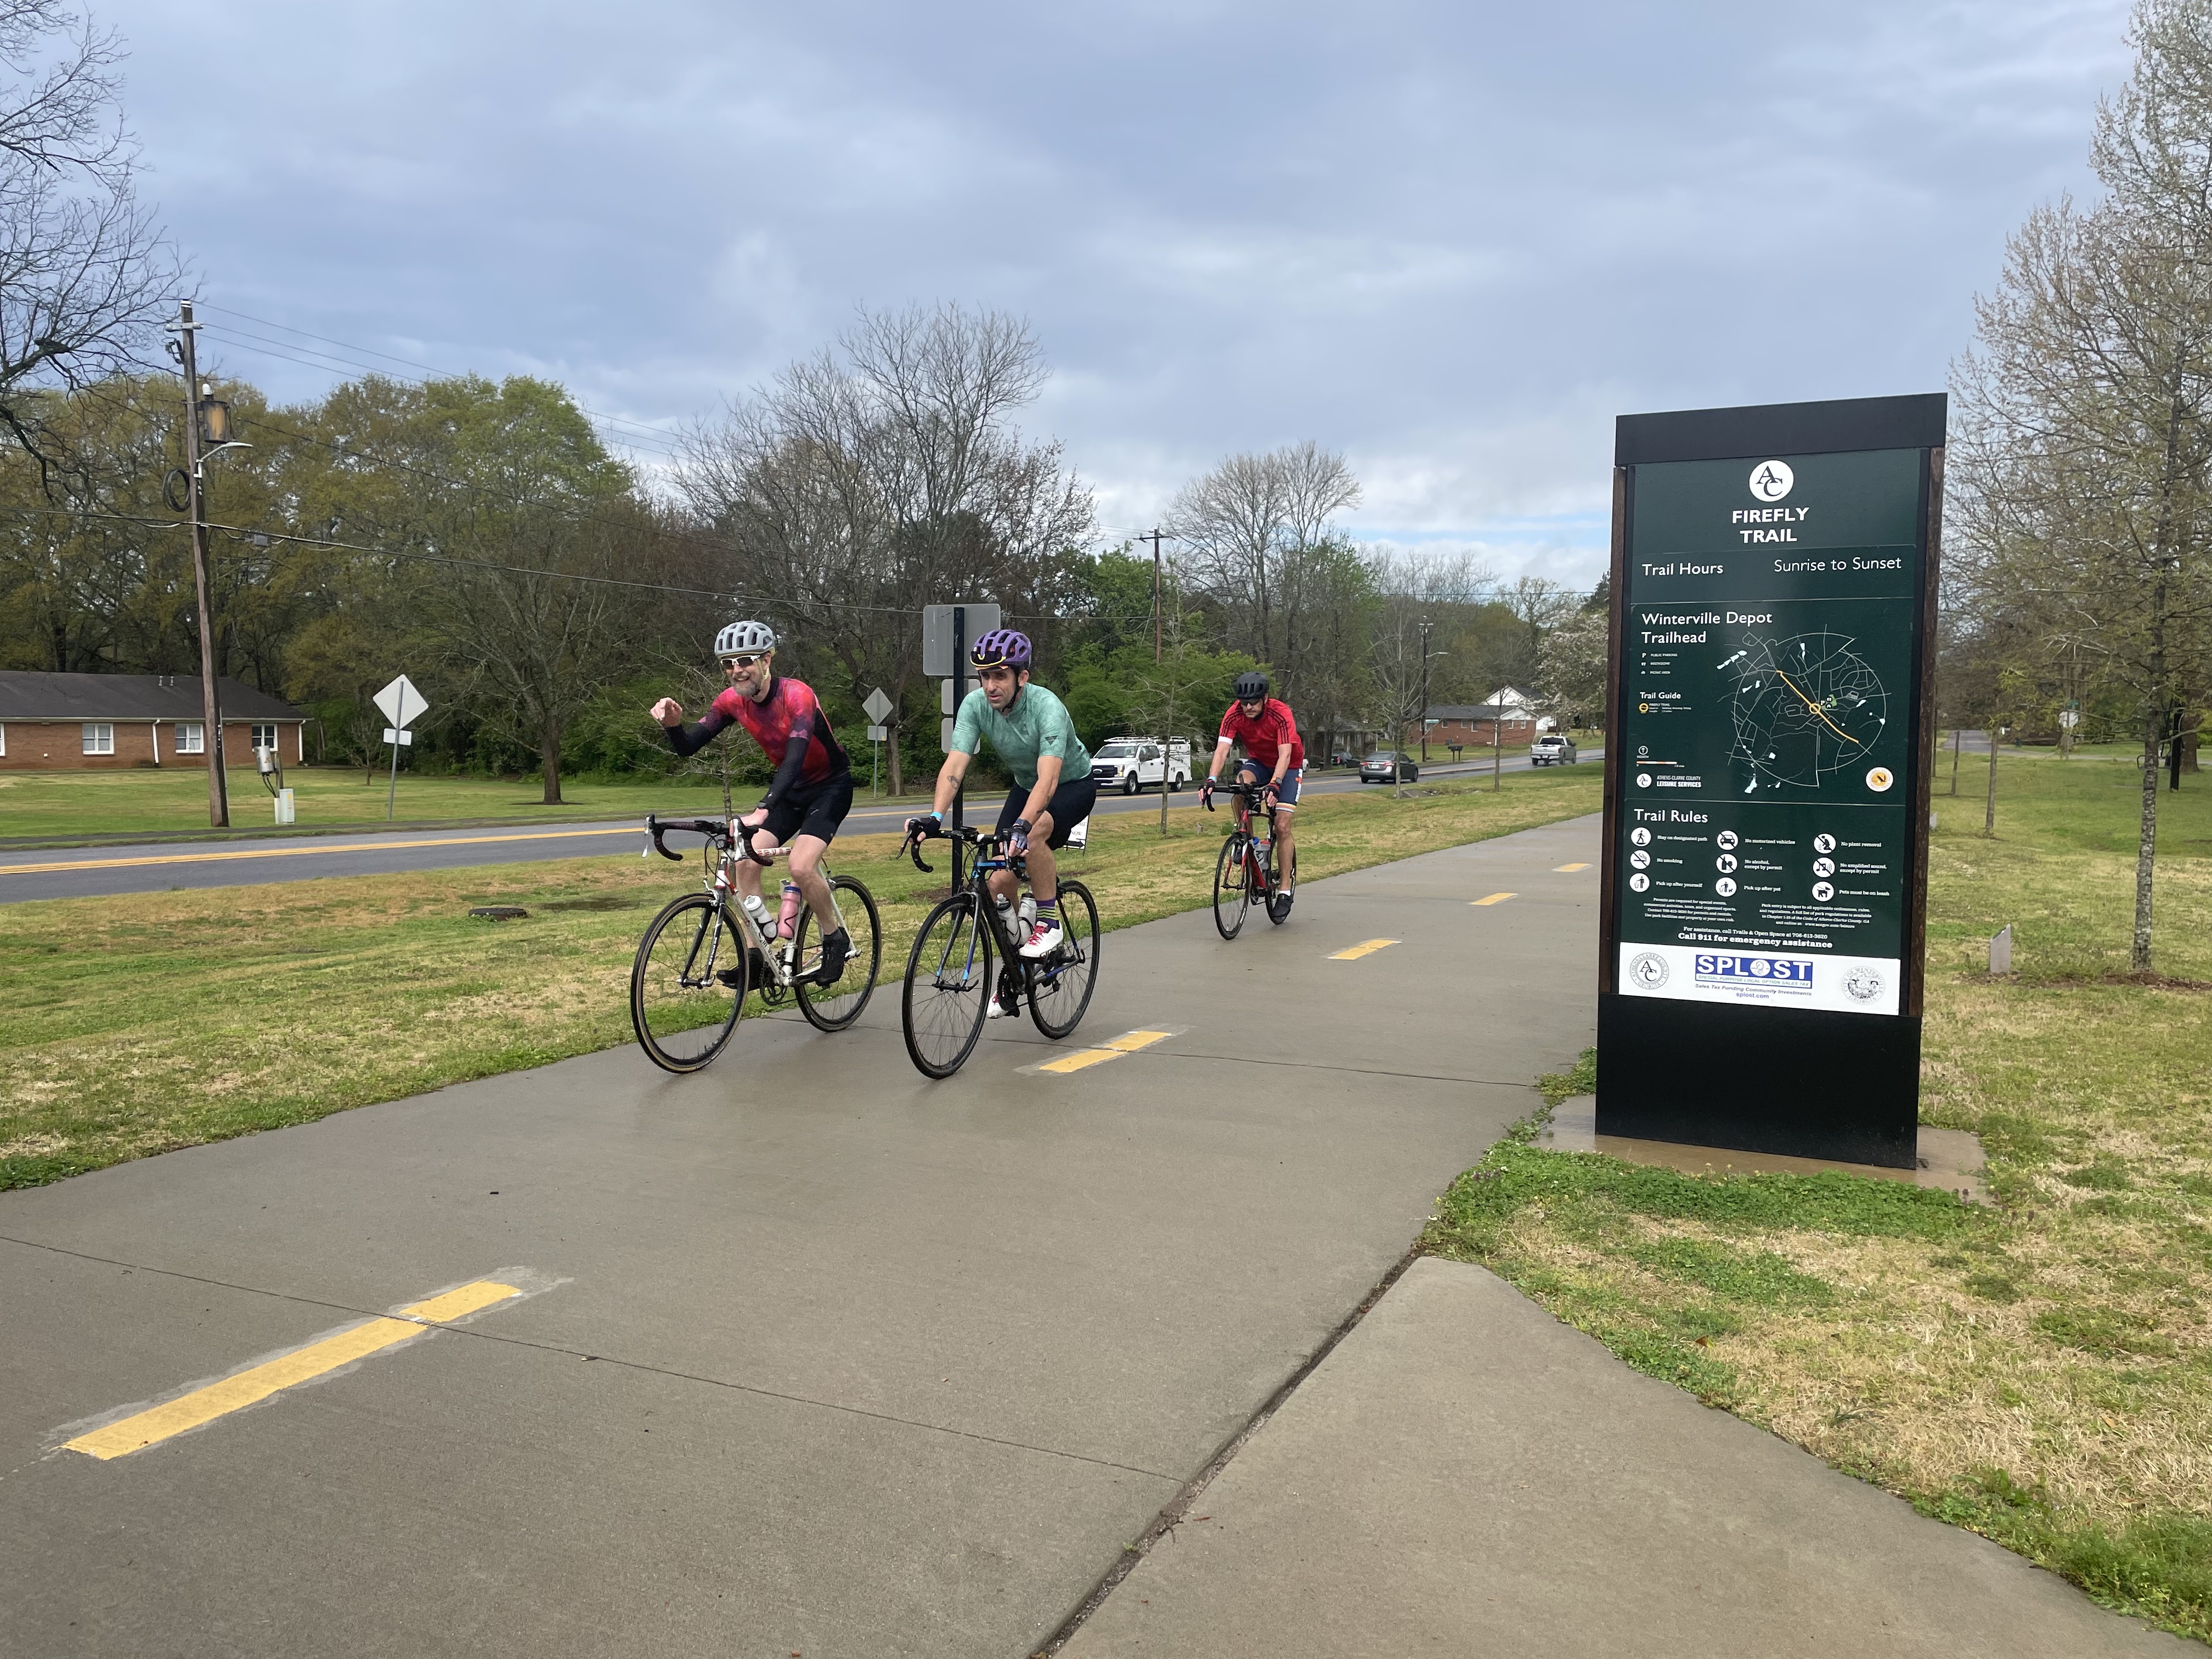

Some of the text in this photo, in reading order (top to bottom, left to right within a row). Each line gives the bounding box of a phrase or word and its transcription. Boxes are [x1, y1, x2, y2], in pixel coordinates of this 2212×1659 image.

[1732, 507, 1809, 523] FIREFLY
[1740, 528, 1797, 544] TRAIL
[1642, 562, 1723, 576] Trail Hours
[1774, 557, 1901, 572] Sunrise to Sunset
[1642, 611, 1772, 627] Winterville Depot
[1641, 631, 1706, 644] Trailhead
[1634, 808, 1708, 823] Trail Rules
[1713, 934, 1728, 942] for
[1729, 936, 1781, 946] emergency
[1782, 939, 1833, 948] assistance
